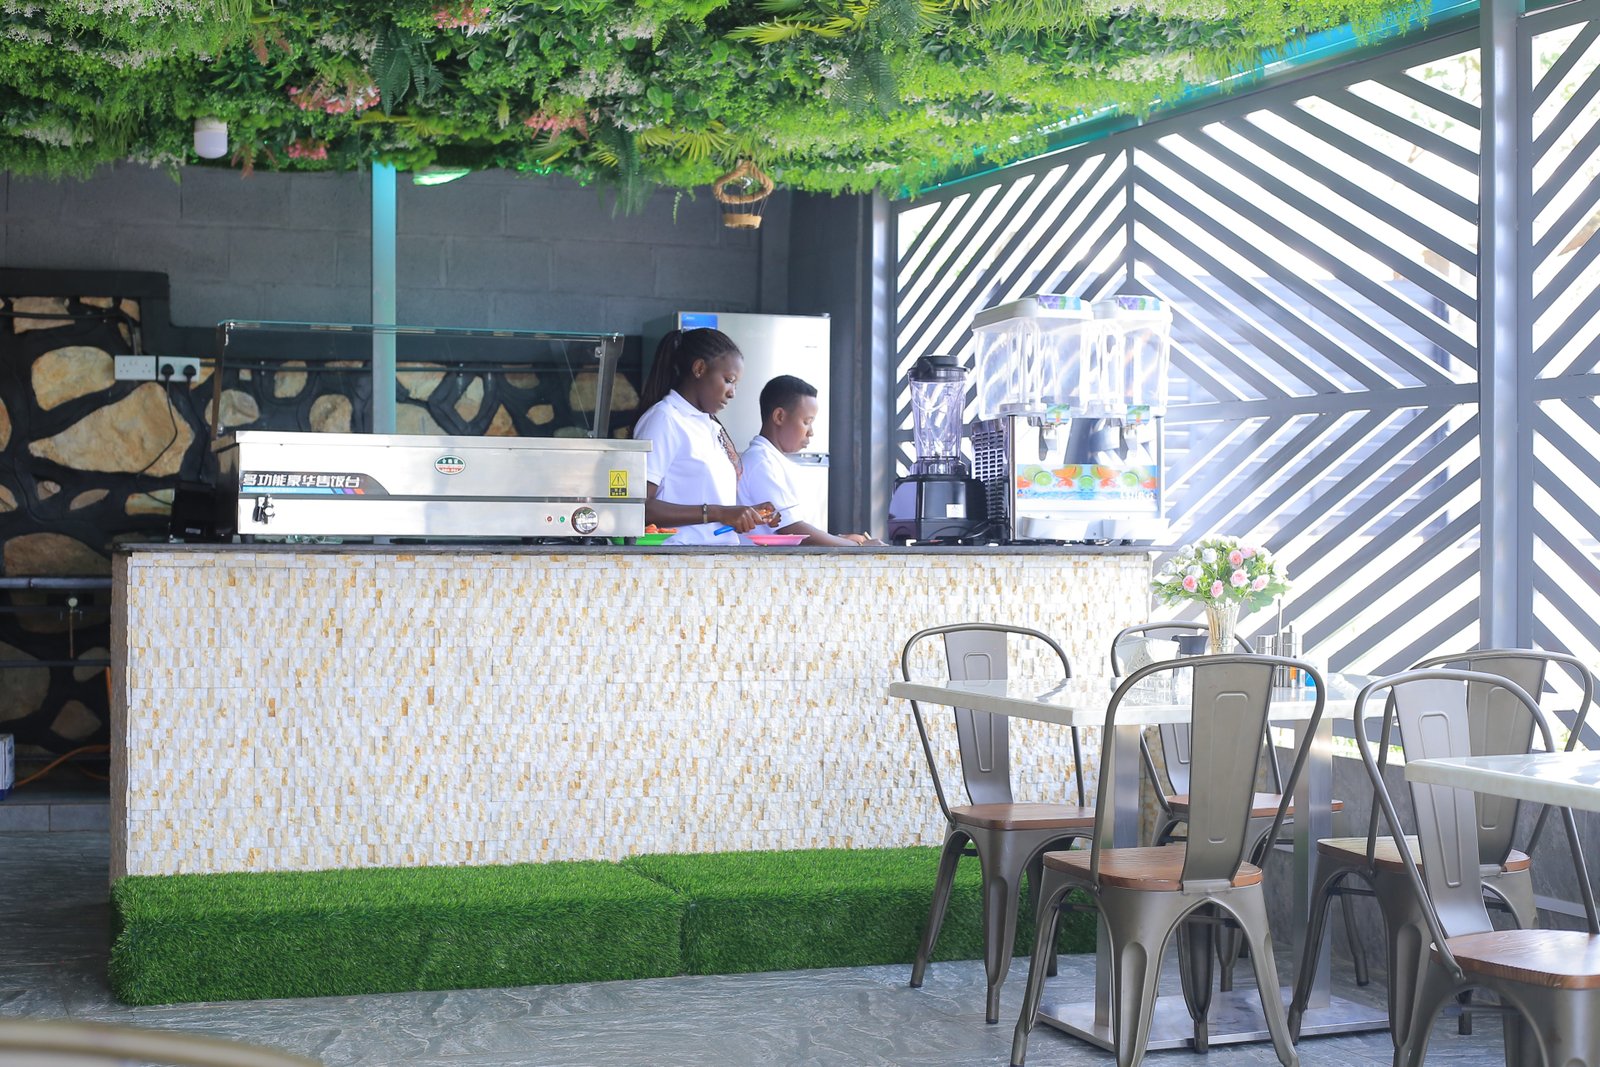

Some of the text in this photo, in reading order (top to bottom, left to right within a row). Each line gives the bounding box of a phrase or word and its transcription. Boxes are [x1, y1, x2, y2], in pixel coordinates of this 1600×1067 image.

[243, 473, 360, 488] 多功能豪华售饭台
